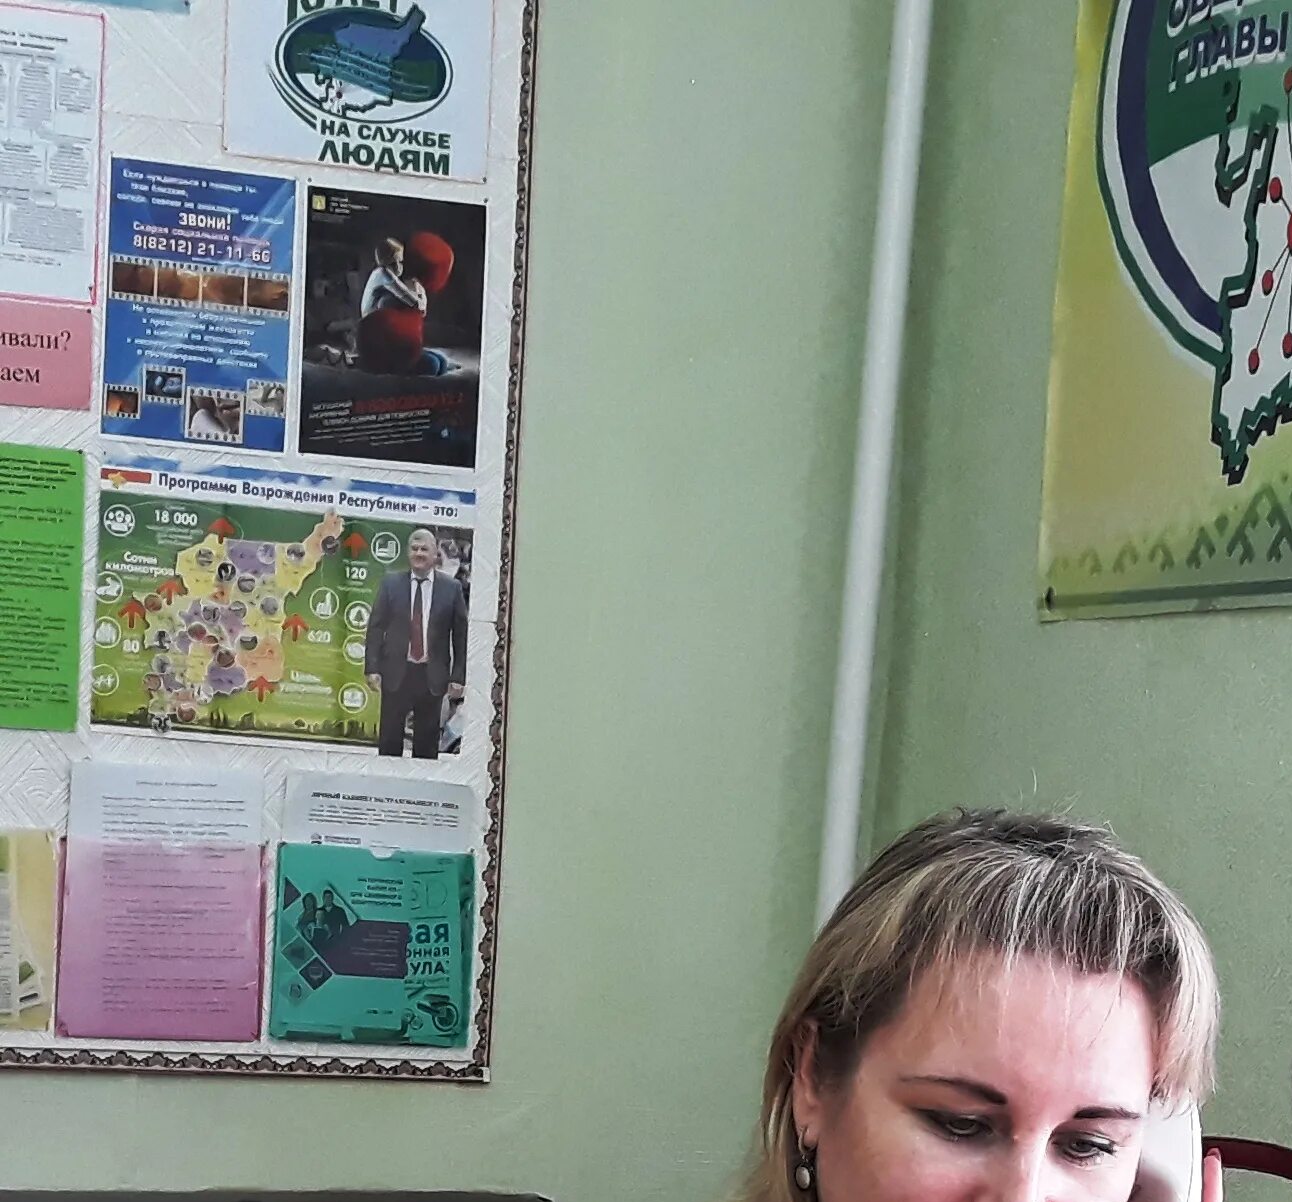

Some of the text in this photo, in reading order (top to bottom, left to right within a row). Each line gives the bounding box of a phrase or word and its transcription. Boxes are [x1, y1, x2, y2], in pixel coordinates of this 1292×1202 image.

[1168, 11, 1289, 93] ГЛАВЫ
[320, 119, 451, 150] НА СЛУЖБЕ
[318, 140, 450, 176] ЛЮДЯМ
[178, 212, 231, 230] ЗВОНИ!
[133, 235, 192, 255] 8(8212)
[0, 366, 40, 383] аем
[159, 473, 237, 494] Программа
[242, 481, 334, 504] Возрождения
[339, 492, 416, 513] Республики
[154, 509, 198, 526] 18 000
[345, 566, 367, 580] 120
